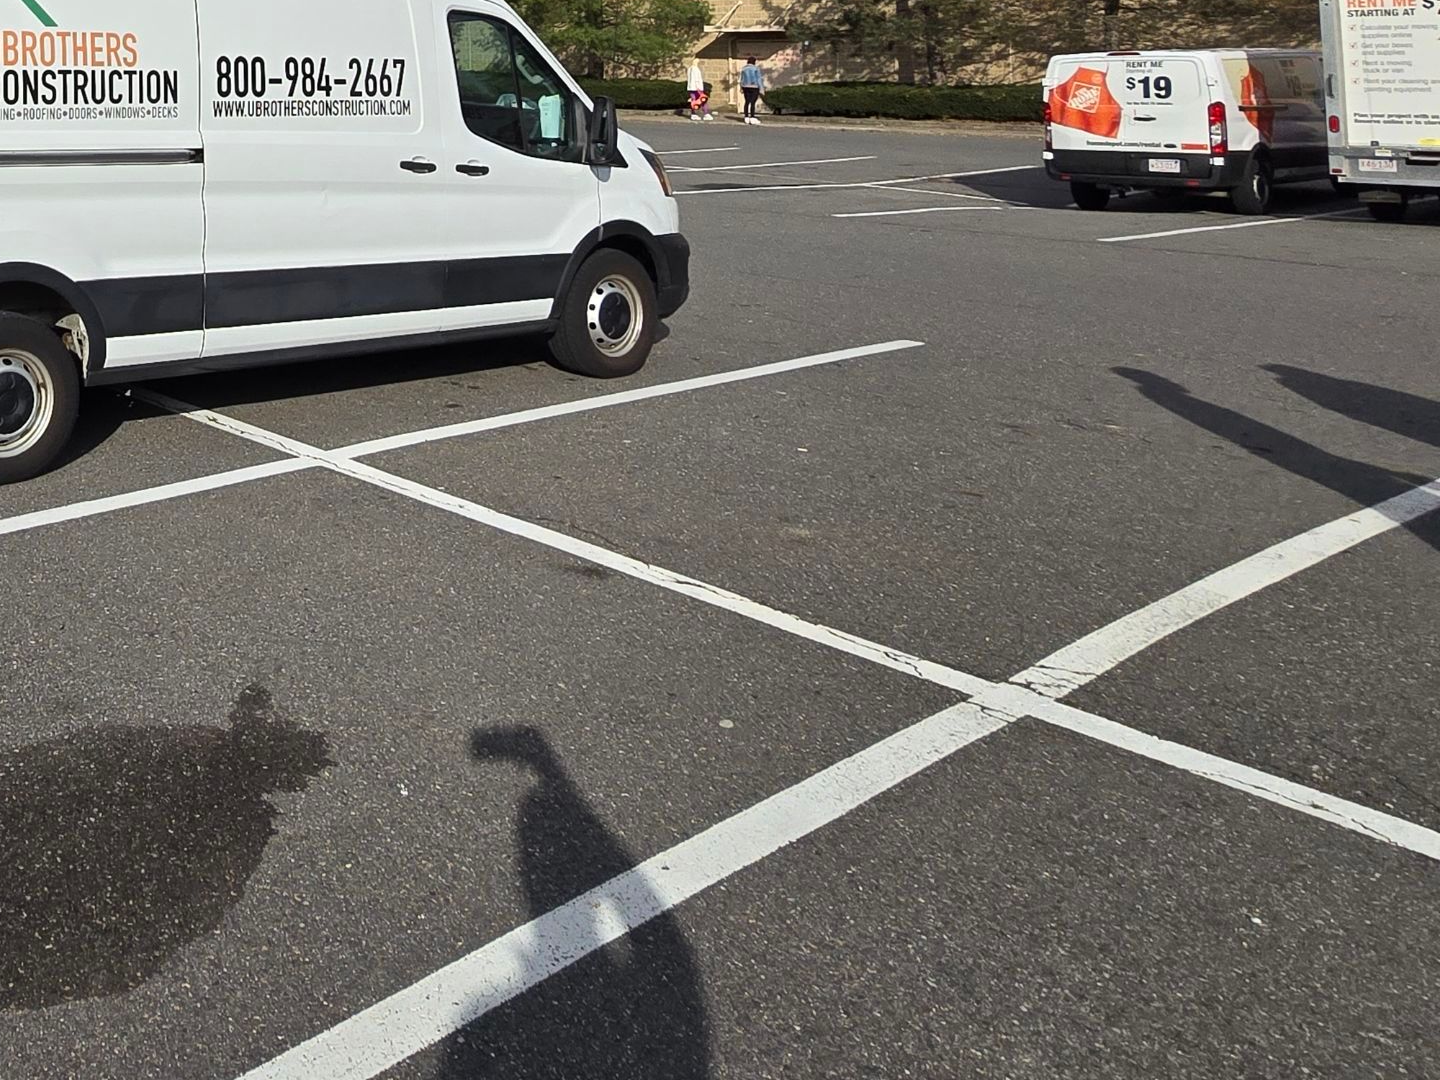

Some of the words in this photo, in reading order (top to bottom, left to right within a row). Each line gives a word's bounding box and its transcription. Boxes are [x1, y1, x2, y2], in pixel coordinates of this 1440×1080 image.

[1347, 9, 1399, 17] STARTING
[1402, 8, 1416, 16] AT
[1125, 61, 1148, 69] RENT
[216, 56, 406, 98] 800-984-2667
[1125, 75, 1173, 99] $19
[213, 100, 411, 117] WWW.UBROTHERSCONSTRUCTION.COM
